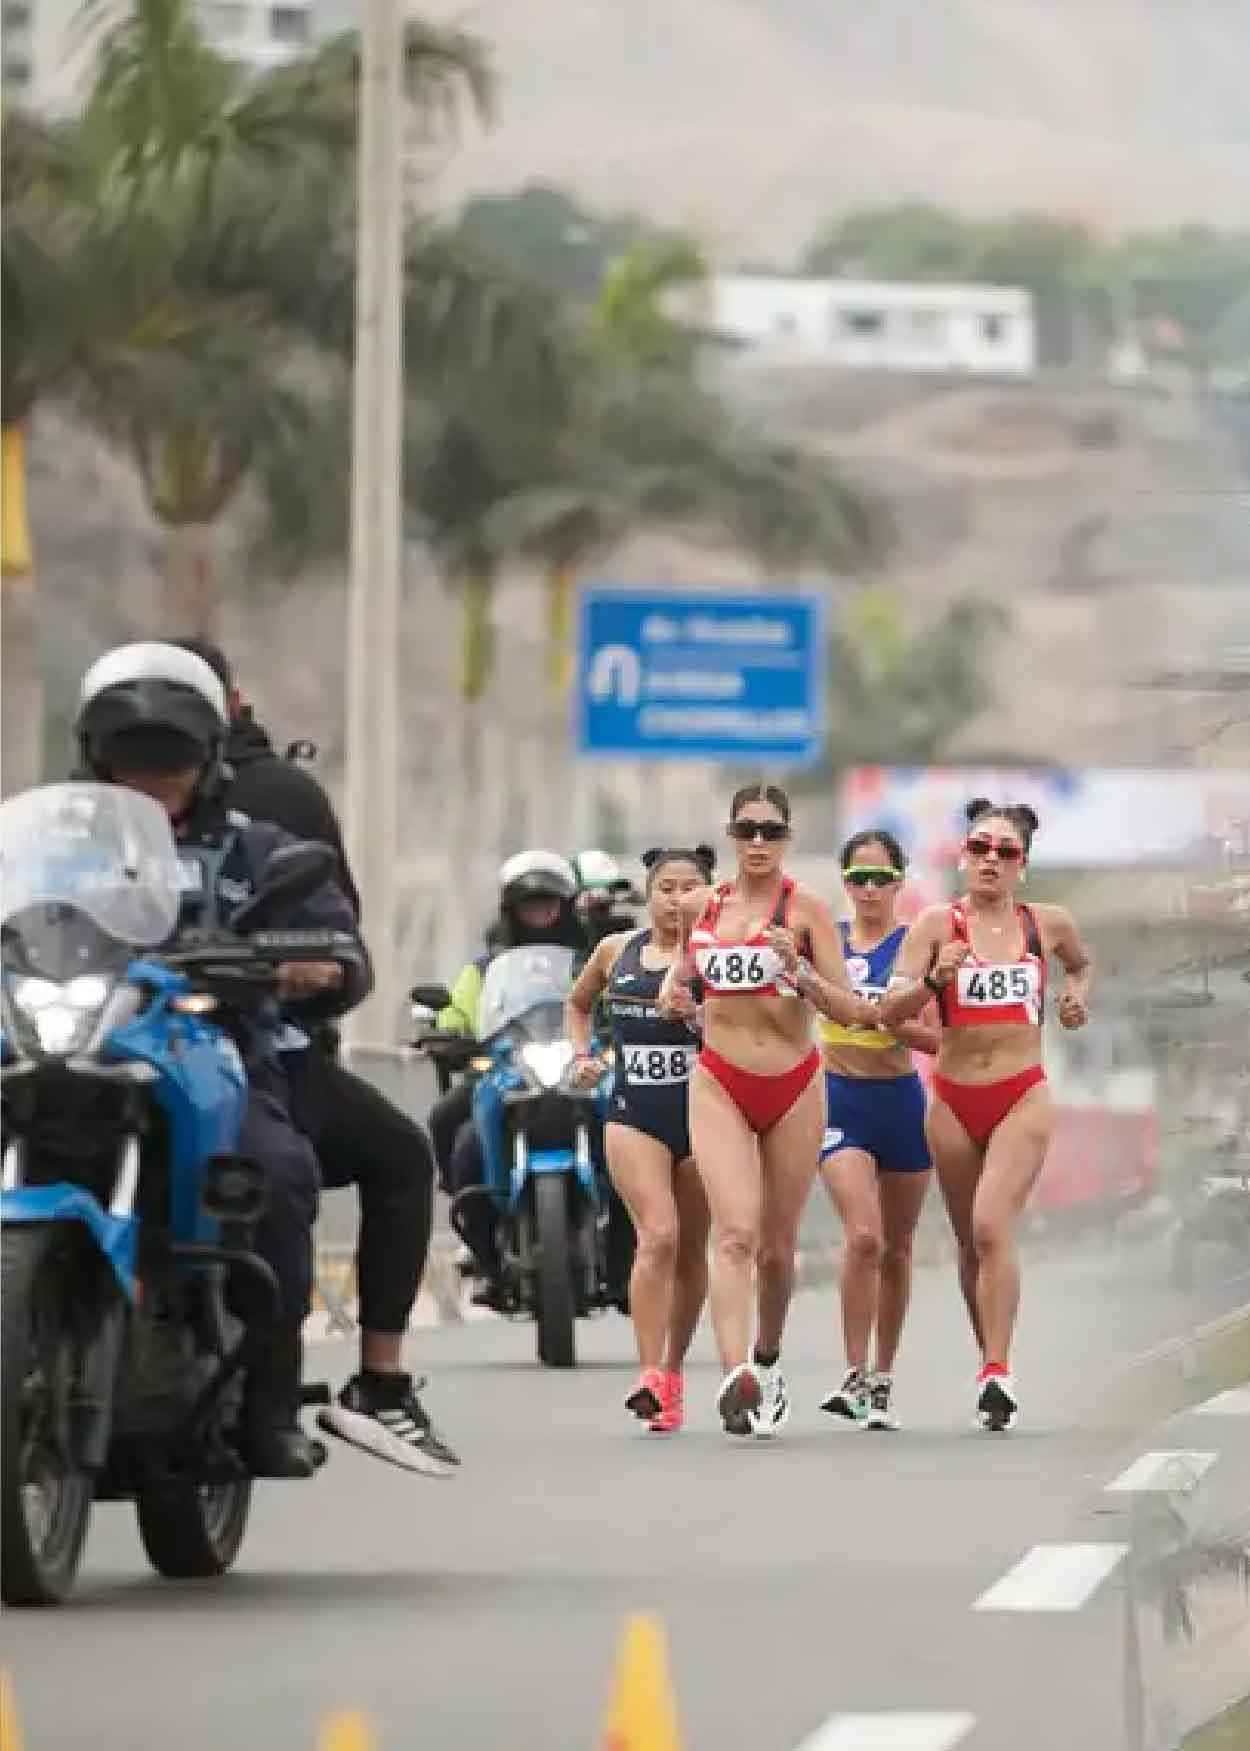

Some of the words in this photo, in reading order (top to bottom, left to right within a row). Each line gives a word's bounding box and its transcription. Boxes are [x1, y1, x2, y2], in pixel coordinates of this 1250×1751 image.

[705, 953, 763, 983] 486
[967, 967, 1028, 1001] 485
[627, 1050, 686, 1079] 488
